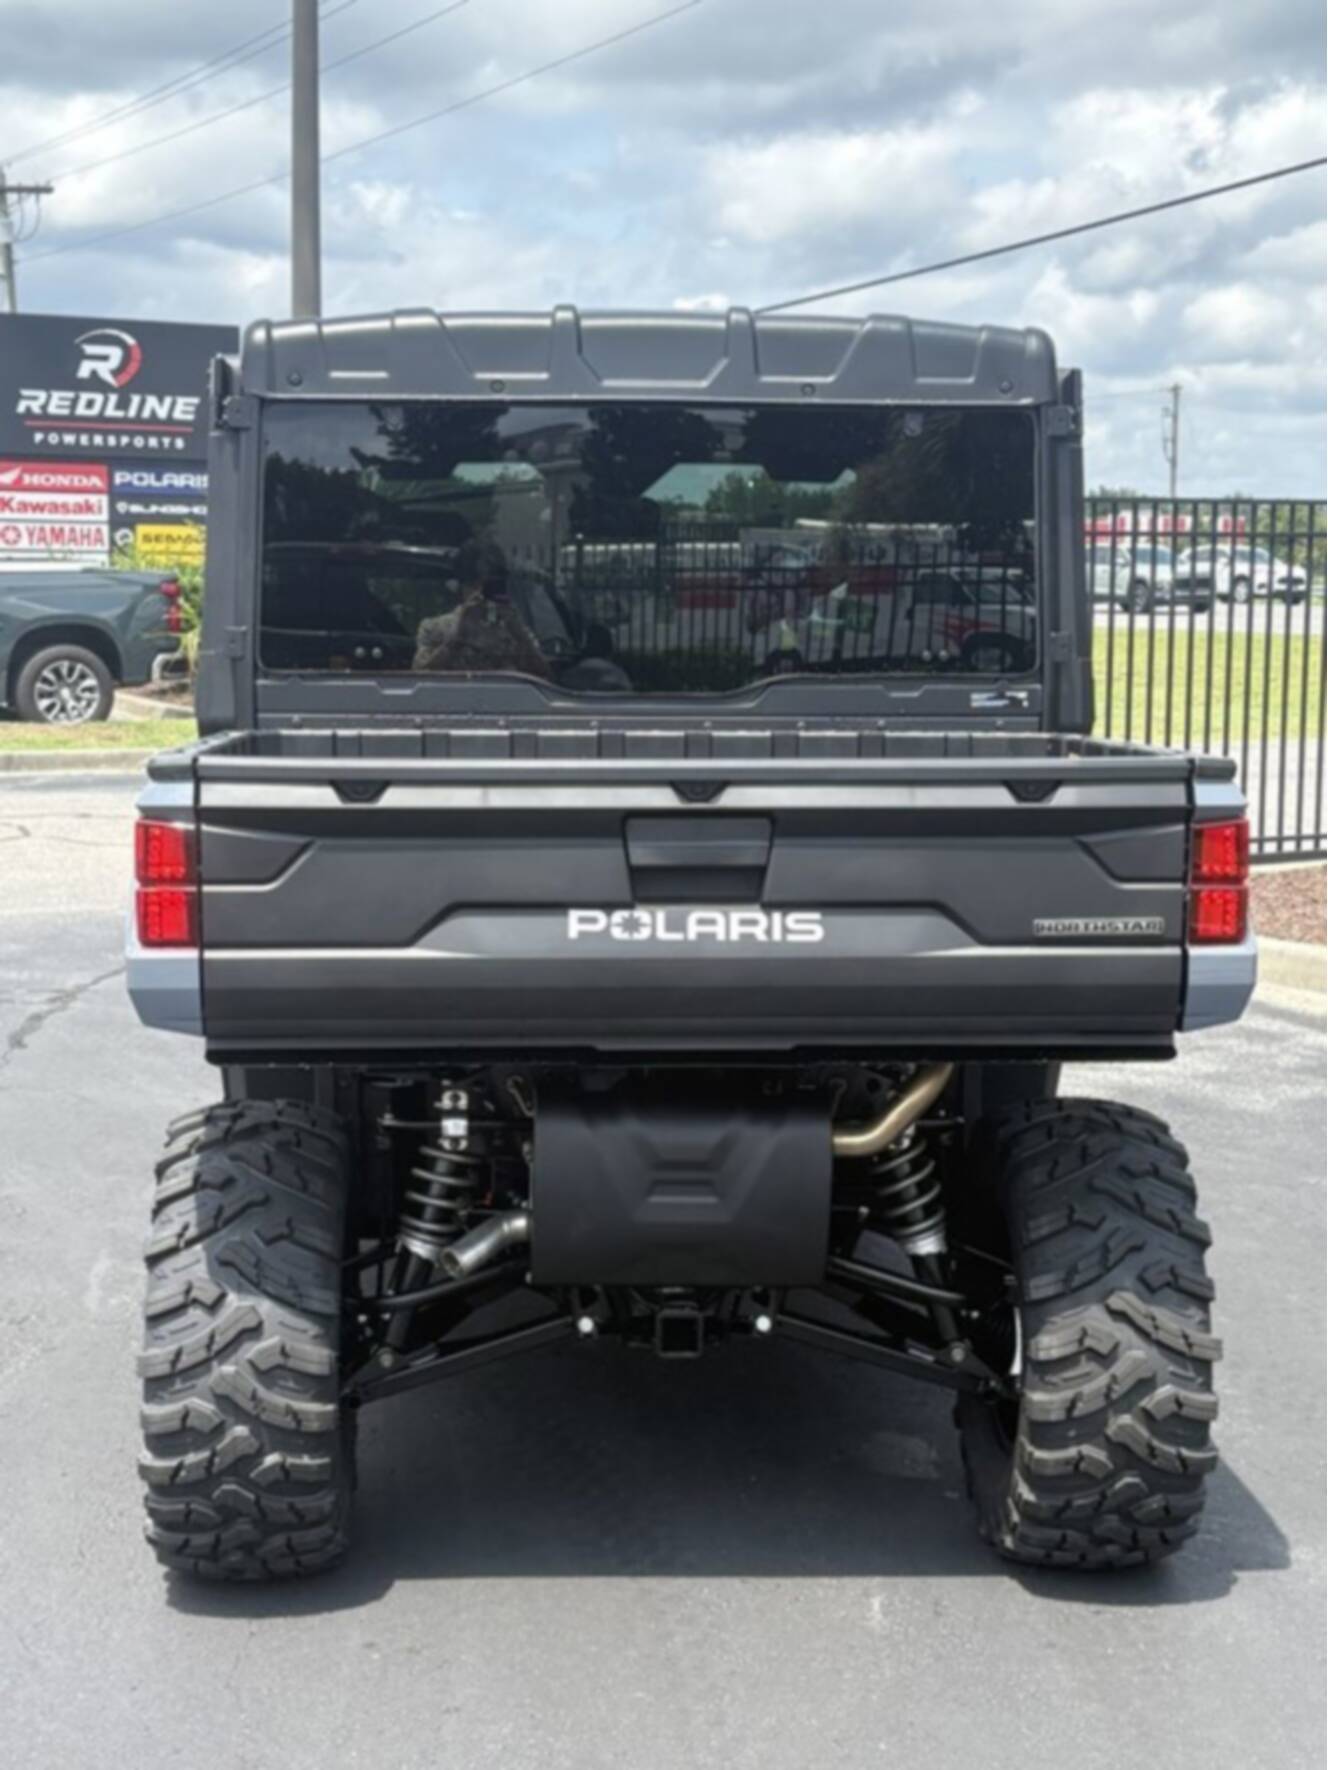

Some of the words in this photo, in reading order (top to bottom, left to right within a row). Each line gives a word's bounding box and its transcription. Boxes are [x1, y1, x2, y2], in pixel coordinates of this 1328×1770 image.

[16, 388, 200, 421] REDLINE
[33, 432, 185, 450] POWERSPORTS
[22, 473, 104, 488] HONDA
[0, 496, 102, 515] Kawasaki
[26, 524, 105, 547] YAMAHA
[567, 908, 825, 942] POLARIS
[1037, 919, 1160, 933] NORTHSTAR
